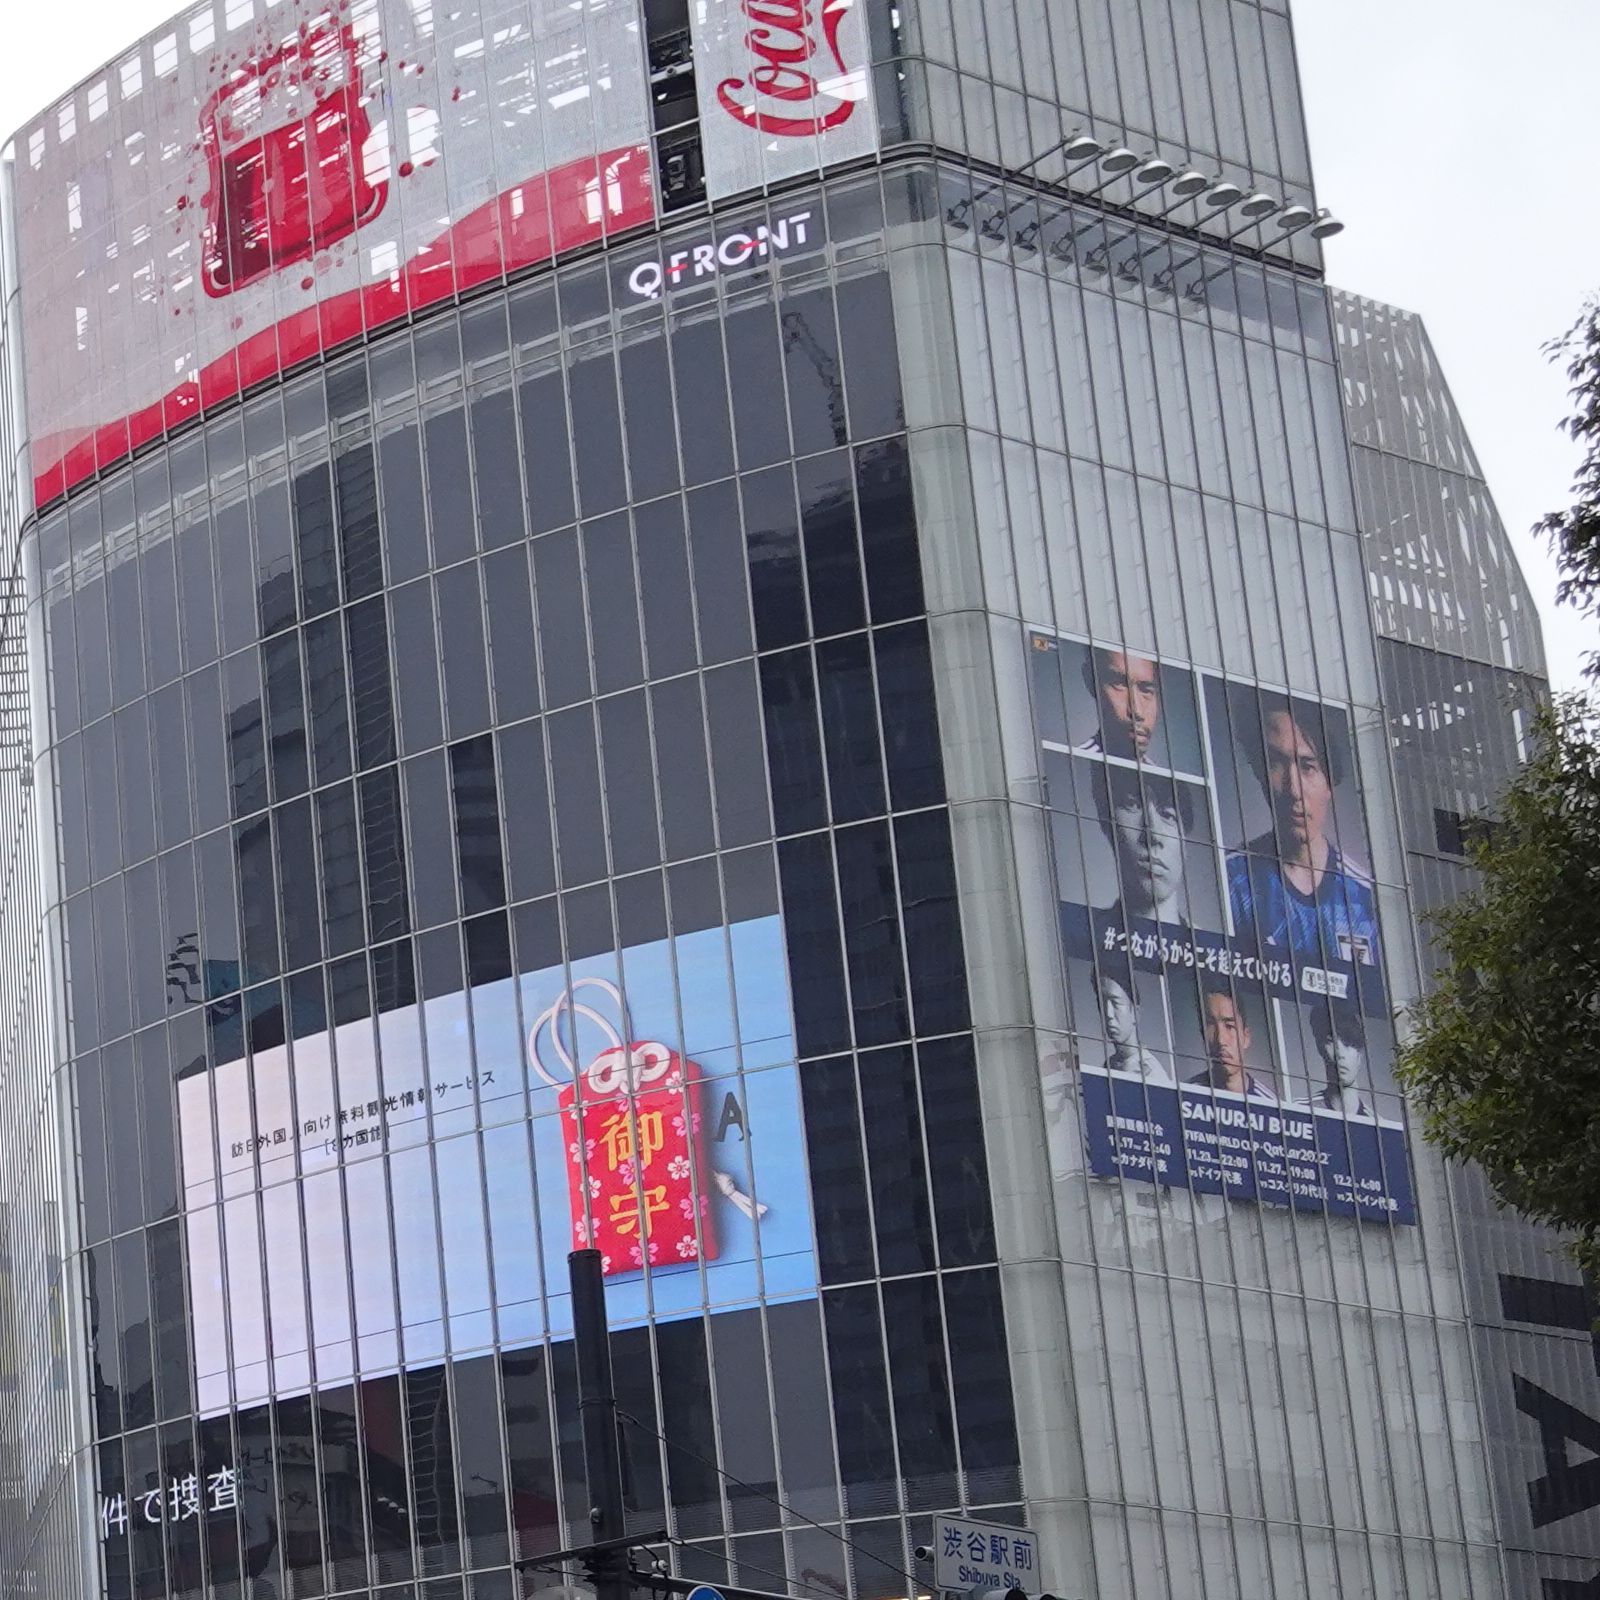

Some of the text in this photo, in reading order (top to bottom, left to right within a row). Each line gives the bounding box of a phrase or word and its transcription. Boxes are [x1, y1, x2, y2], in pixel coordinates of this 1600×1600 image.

[600, 1112, 670, 1240] 御守
[943, 1526, 1033, 1571] 渋谷駅前
[958, 1564, 1000, 1588] Shibuya
